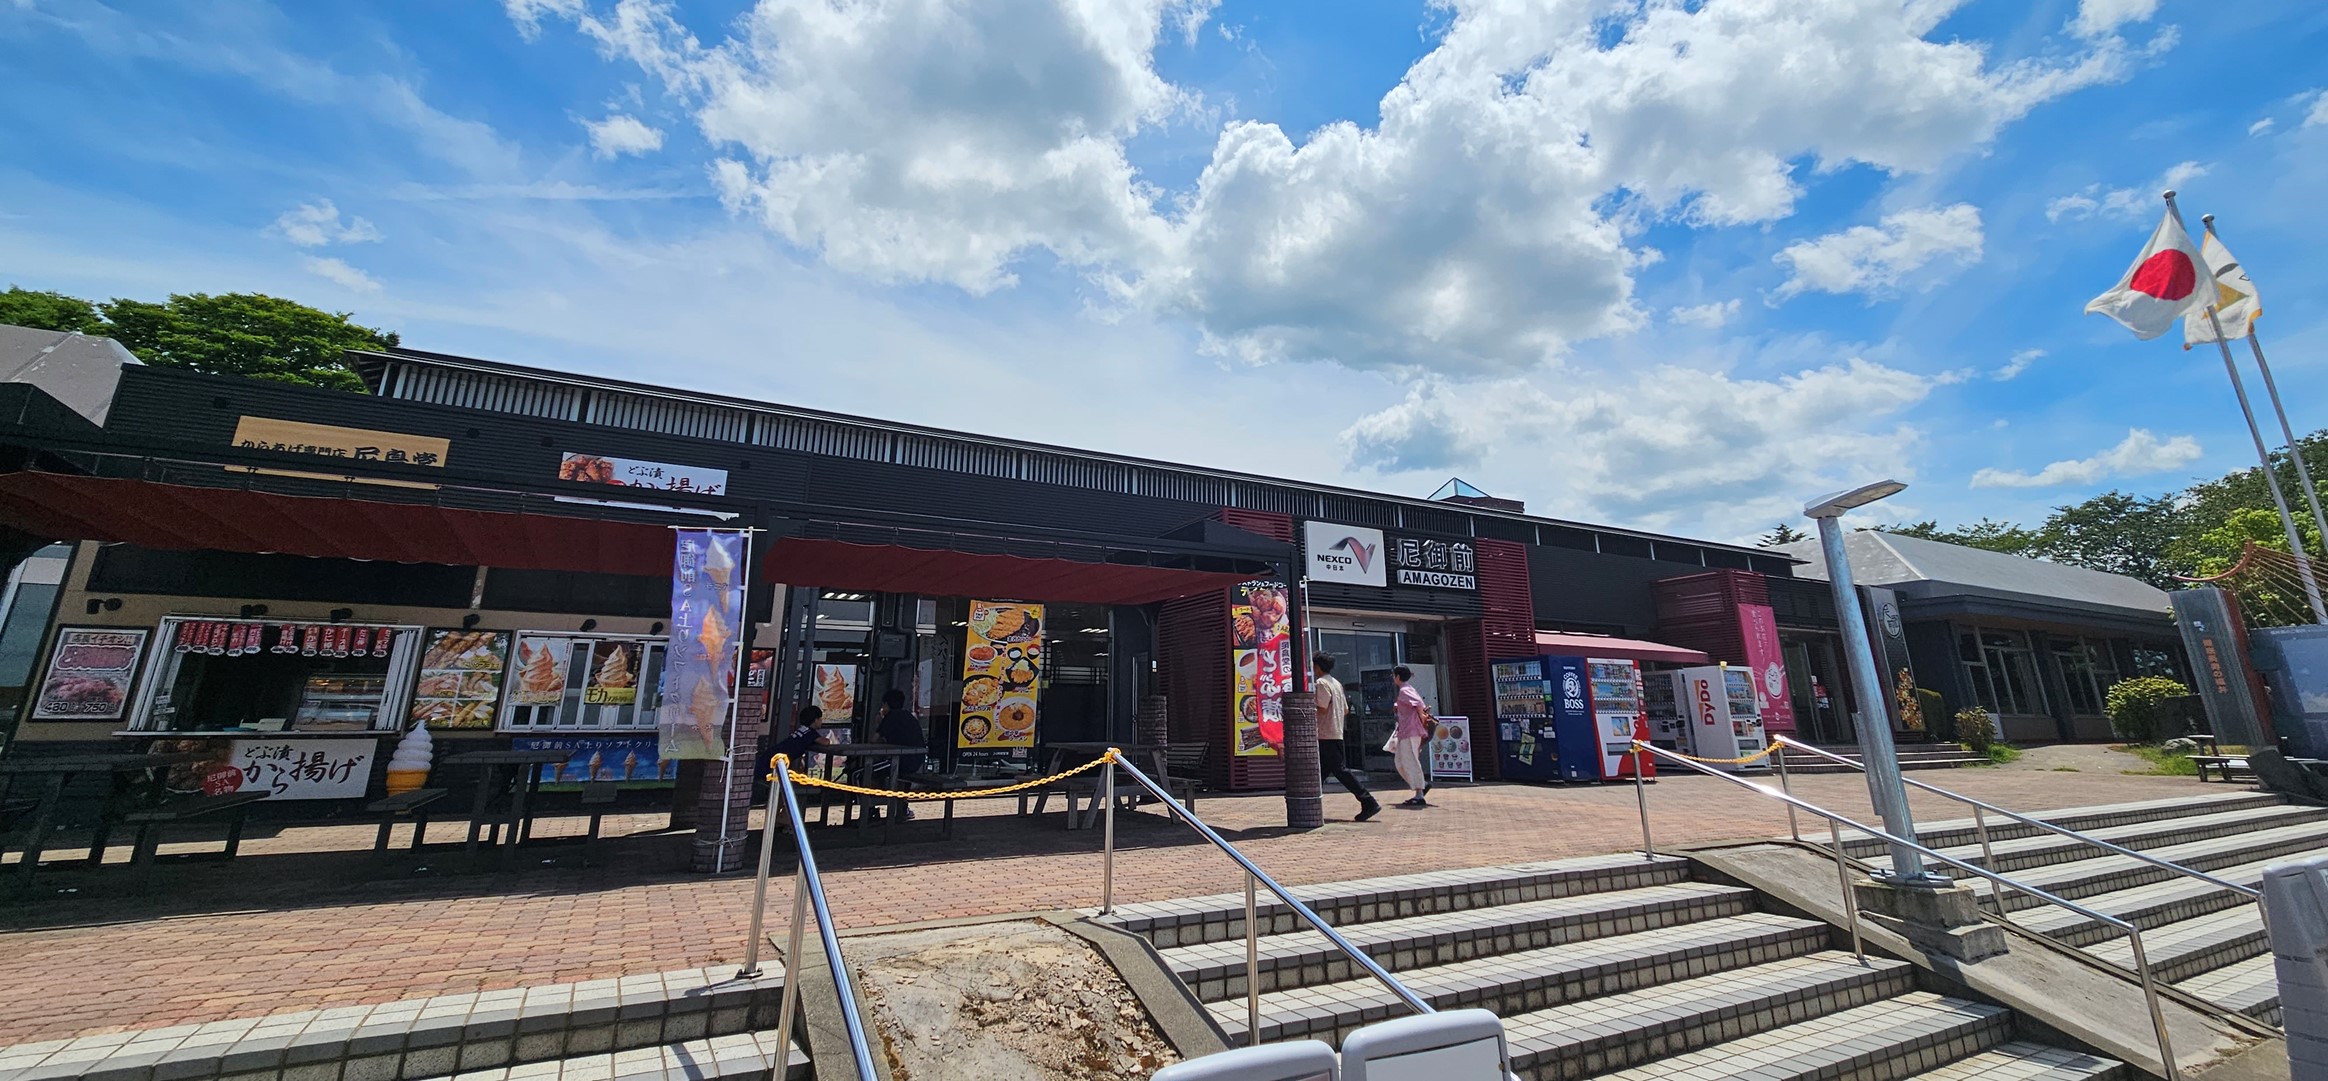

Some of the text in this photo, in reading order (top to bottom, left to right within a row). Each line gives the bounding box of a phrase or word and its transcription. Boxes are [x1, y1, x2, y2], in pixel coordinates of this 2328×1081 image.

[627, 465, 665, 480] どぶ漬
[630, 476, 721, 496] か揚げ
[1317, 554, 1352, 565] NEXCO
[1398, 538, 1475, 573] 尼御前
[1403, 572, 1474, 589] AMAGOZEN
[1563, 698, 1584, 709] BOSS
[245, 744, 294, 761] どぶ漬
[243, 751, 365, 795] から揚げ
